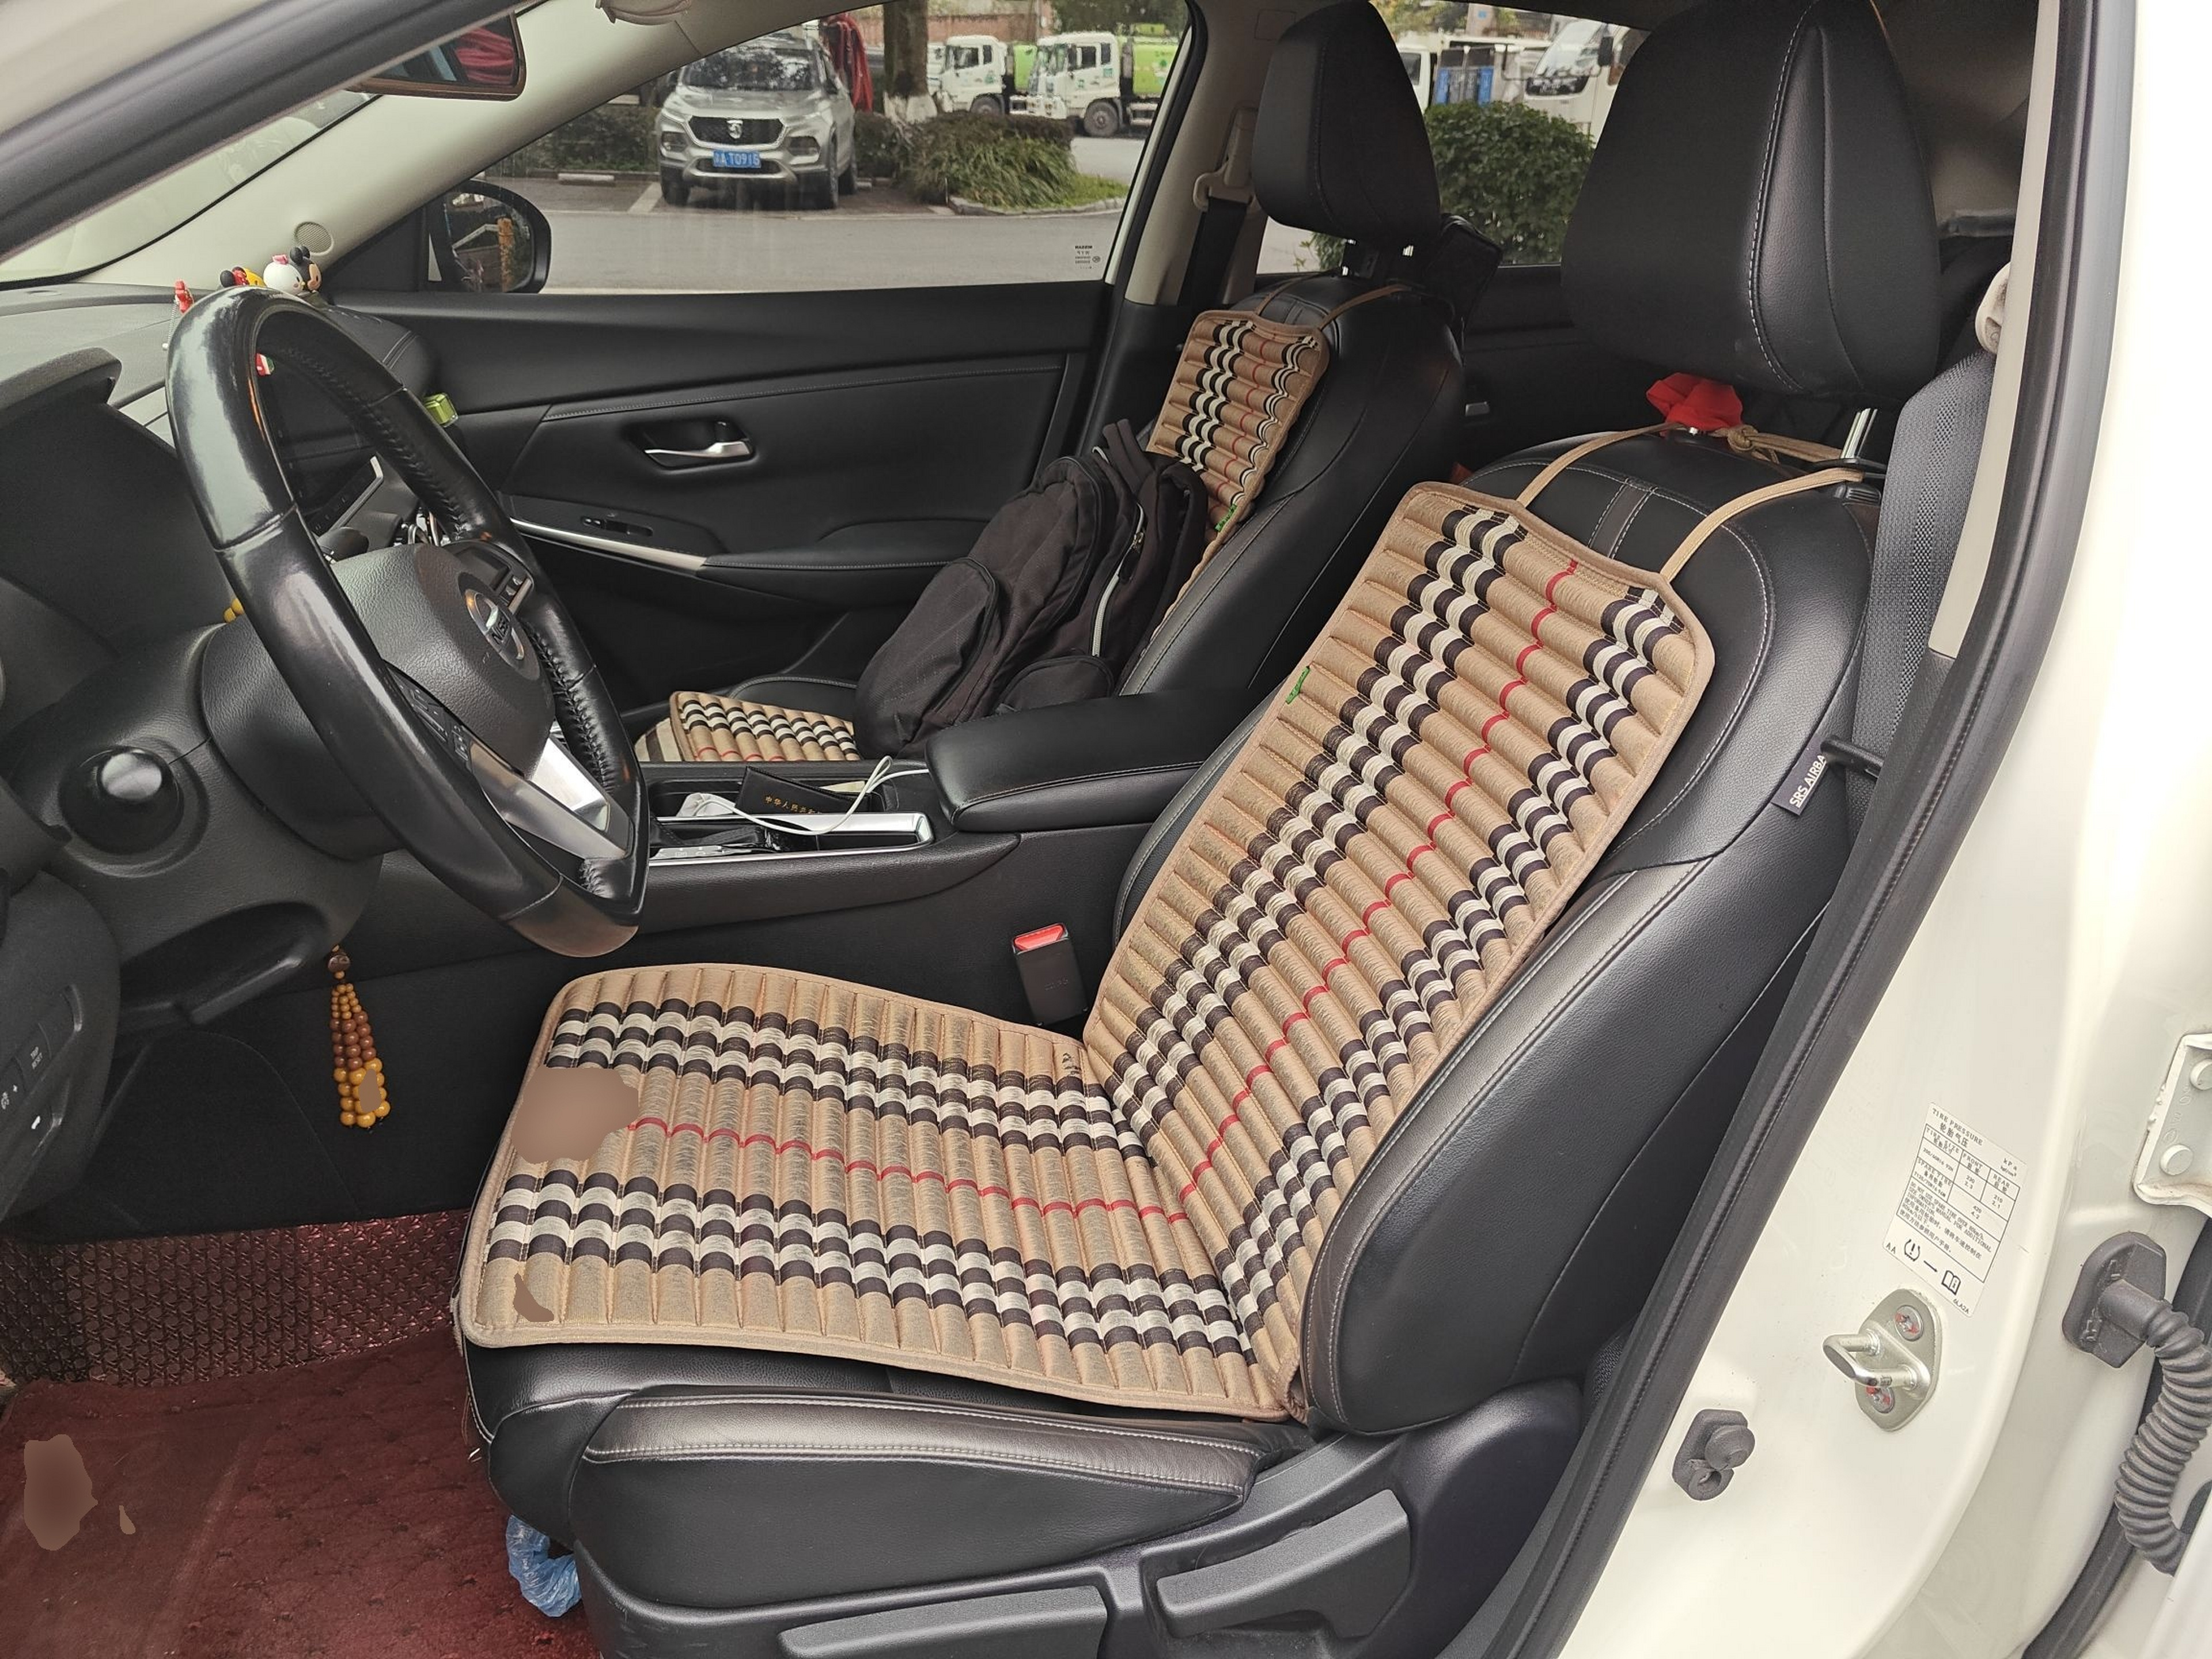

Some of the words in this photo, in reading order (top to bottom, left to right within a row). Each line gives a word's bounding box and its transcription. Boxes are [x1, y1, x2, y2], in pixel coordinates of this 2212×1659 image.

[1789, 785, 1808, 808] SRS
[1804, 755, 1826, 787] AIRBA
[764, 795, 822, 814] 中华人民共和
[1931, 1107, 1948, 1123] TIRE
[1949, 1119, 1983, 1146] PRESSURE
[1939, 1122, 1969, 1148] 轮胎气压
[1963, 1153, 1983, 1169] FRONT
[1964, 1181, 1973, 1190] 2.3
[1966, 1175, 1975, 1184] 230
[1993, 1173, 2010, 1188] REAR
[1970, 1210, 1979, 1219] 4.2
[1972, 1205, 1982, 1214] 420
[1885, 1241, 1897, 1254] AA
